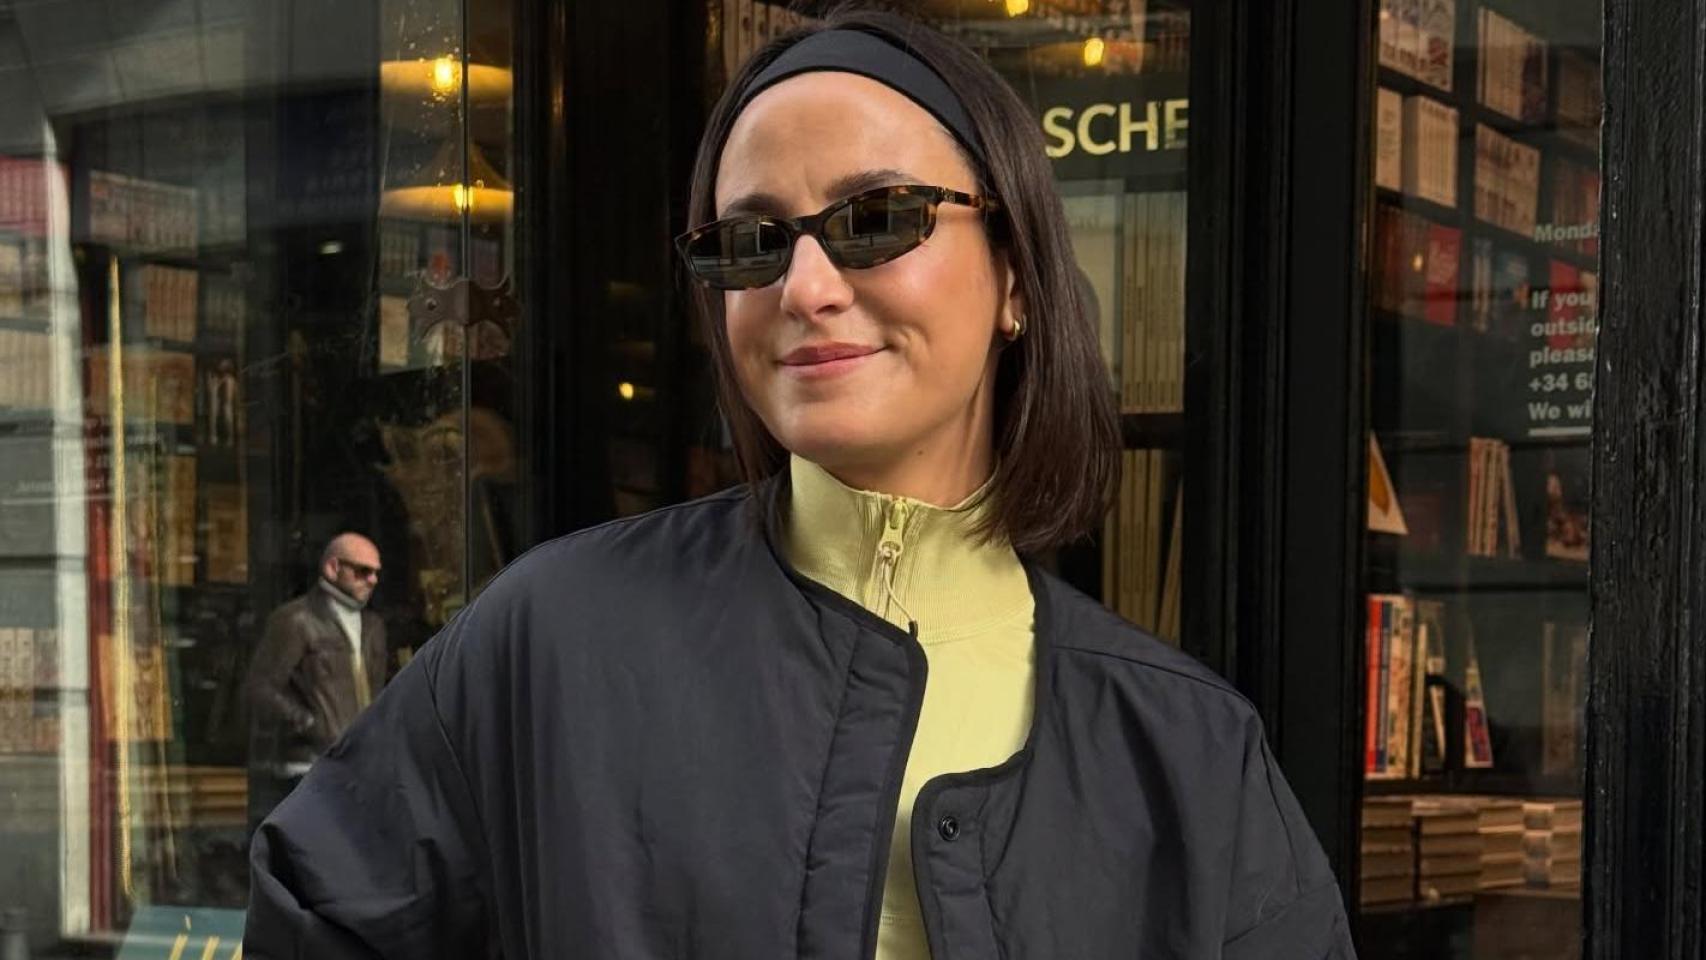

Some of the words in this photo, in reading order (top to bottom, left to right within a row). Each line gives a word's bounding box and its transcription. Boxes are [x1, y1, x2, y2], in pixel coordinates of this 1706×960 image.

[1532, 290, 1549, 309] If
[1555, 292, 1595, 311] you
[1529, 372, 1568, 392] +34
[1575, 372, 1592, 390] 6
[1528, 401, 1561, 420] We
